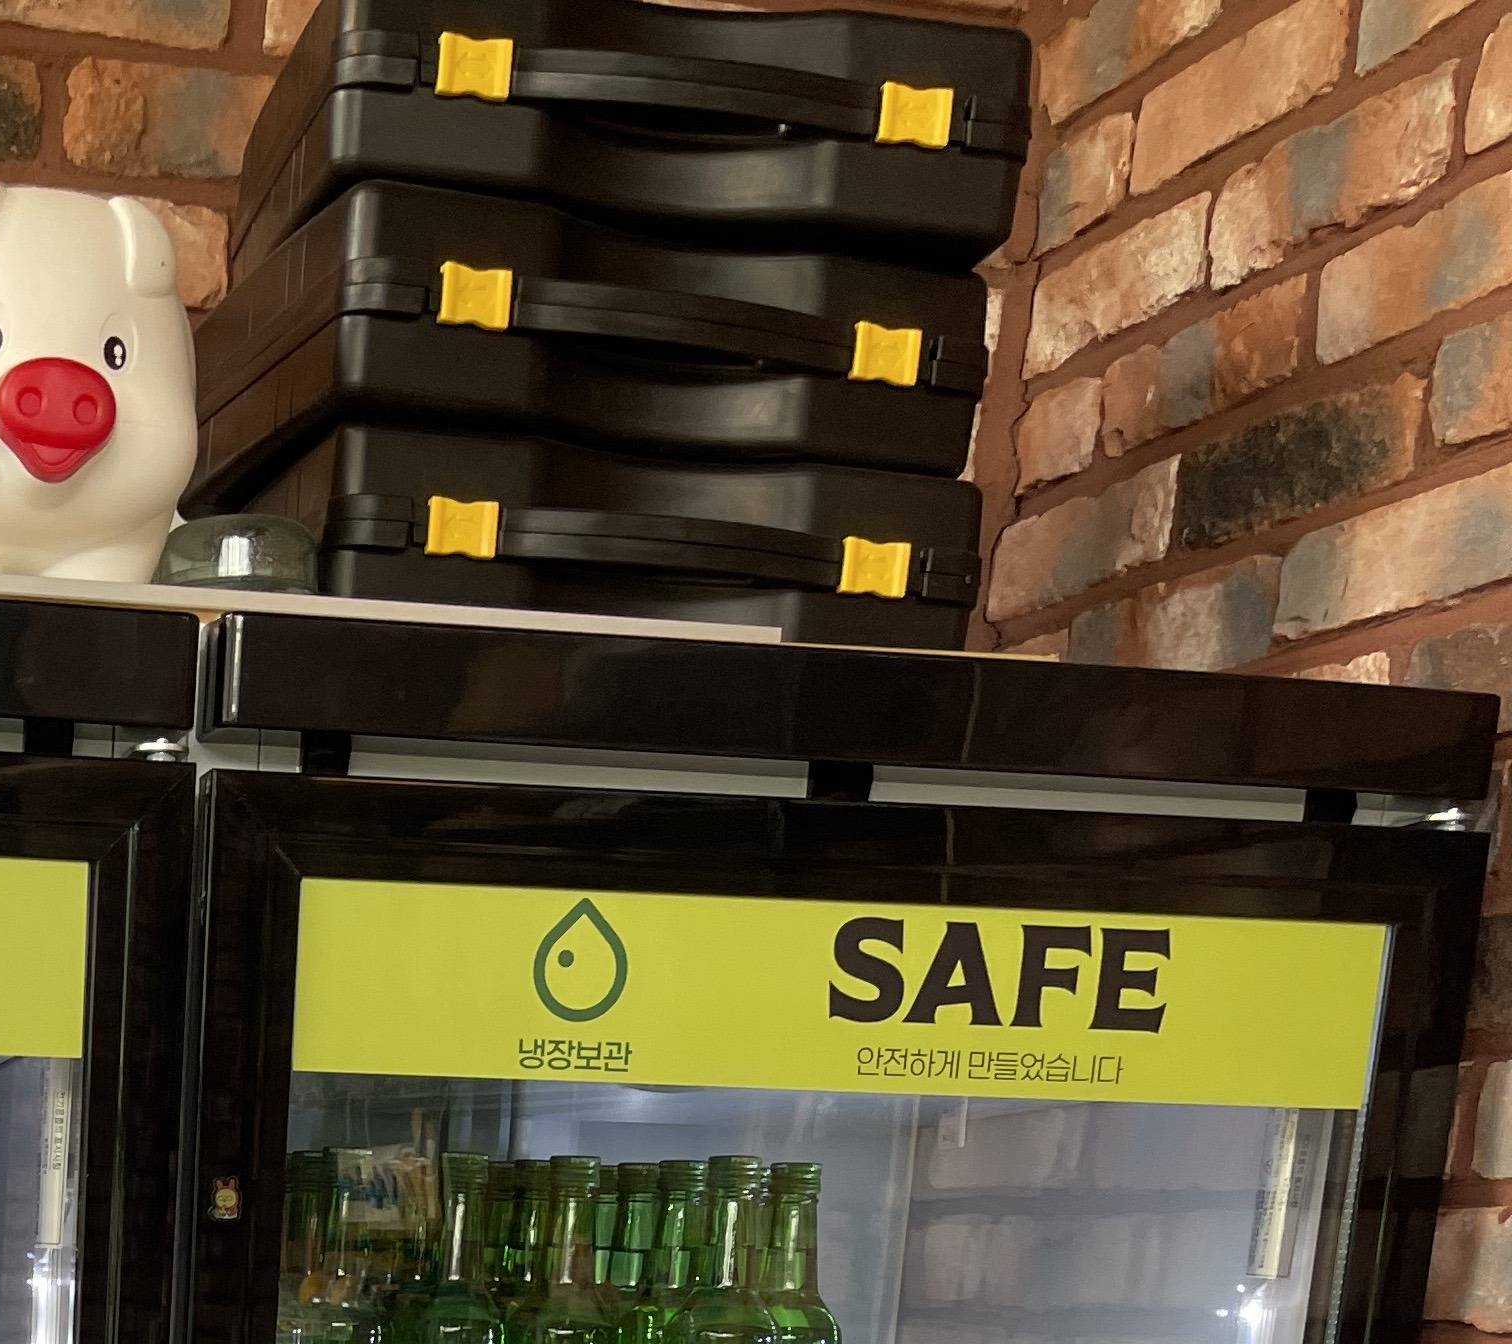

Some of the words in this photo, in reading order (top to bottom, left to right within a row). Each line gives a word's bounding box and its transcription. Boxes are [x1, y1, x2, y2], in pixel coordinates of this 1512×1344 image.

[828, 916, 1174, 1034] SAFE
[517, 1036, 633, 1074] 냉장보관
[855, 1045, 963, 1081] 안전하게
[966, 1049, 1125, 1086] 만들었습니다
